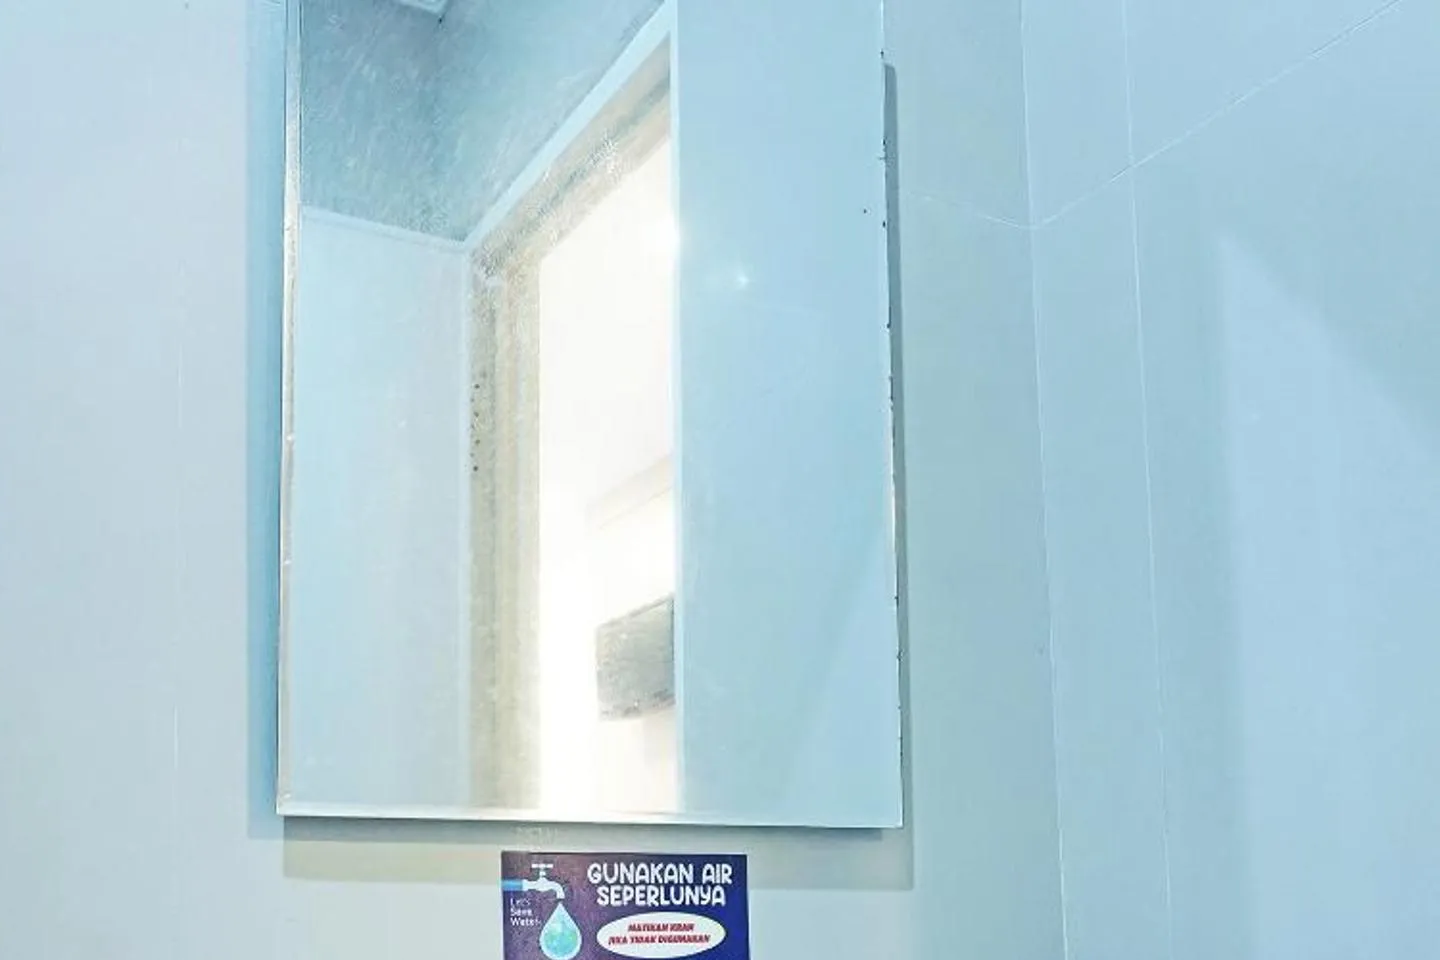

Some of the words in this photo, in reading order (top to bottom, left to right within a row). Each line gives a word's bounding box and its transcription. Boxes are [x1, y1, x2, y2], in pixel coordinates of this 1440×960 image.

[587, 862, 694, 884] GUNAKAN
[702, 863, 733, 884] AIR
[596, 885, 726, 907] SEPERLUNYA
